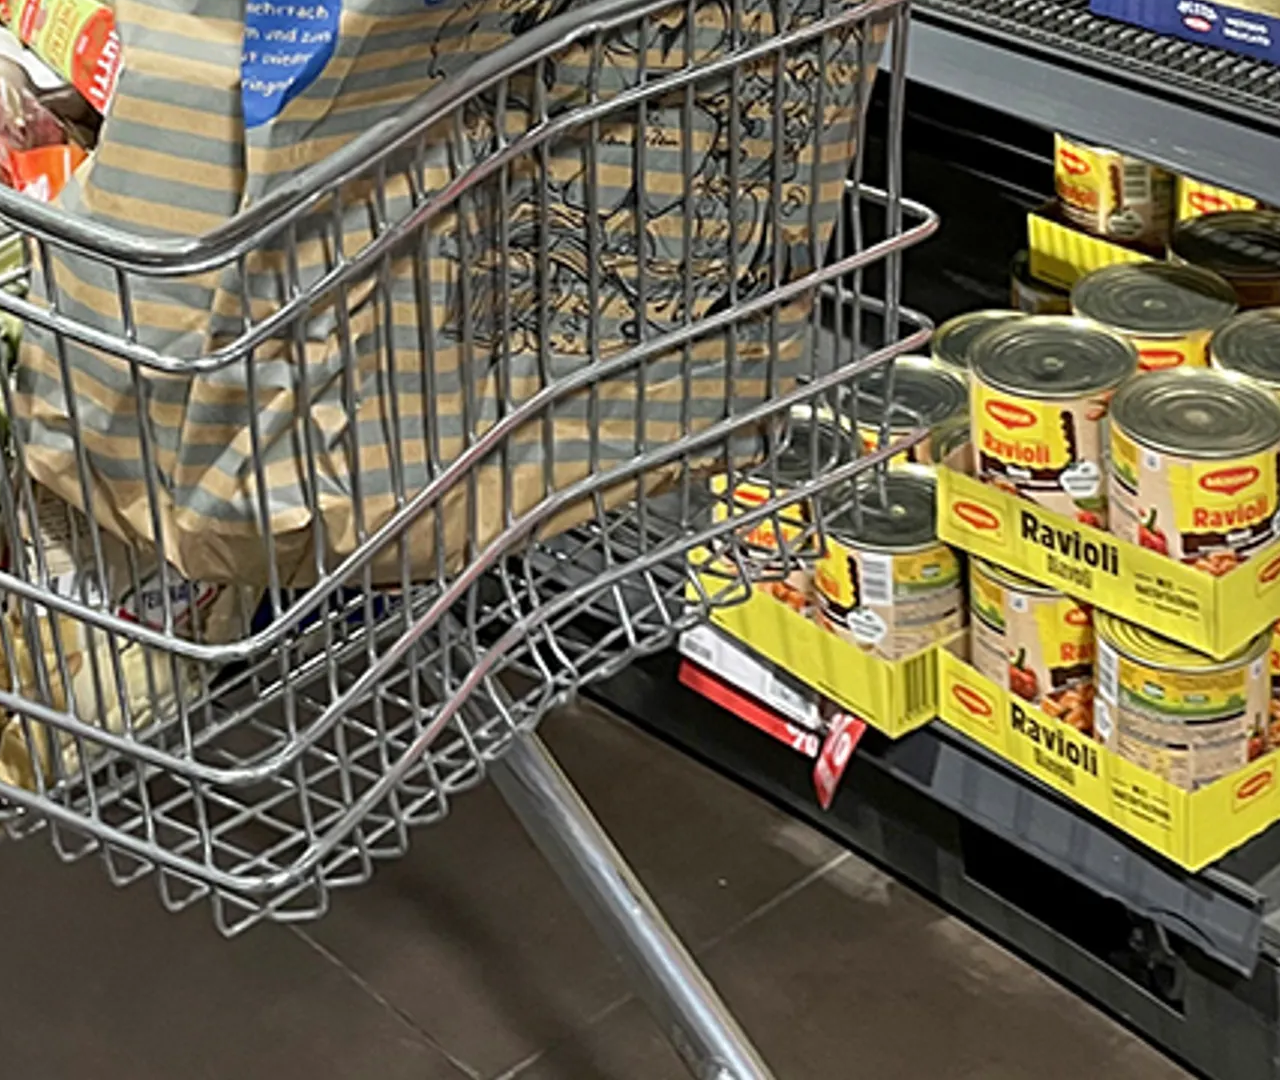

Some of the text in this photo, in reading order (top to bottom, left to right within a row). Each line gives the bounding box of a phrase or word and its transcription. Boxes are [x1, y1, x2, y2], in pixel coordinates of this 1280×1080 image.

[984, 429, 1050, 464] Ravioli
[1193, 494, 1269, 528] Ravioli
[1021, 510, 1119, 577] Ravioli
[1010, 701, 1099, 777] Ravioli
